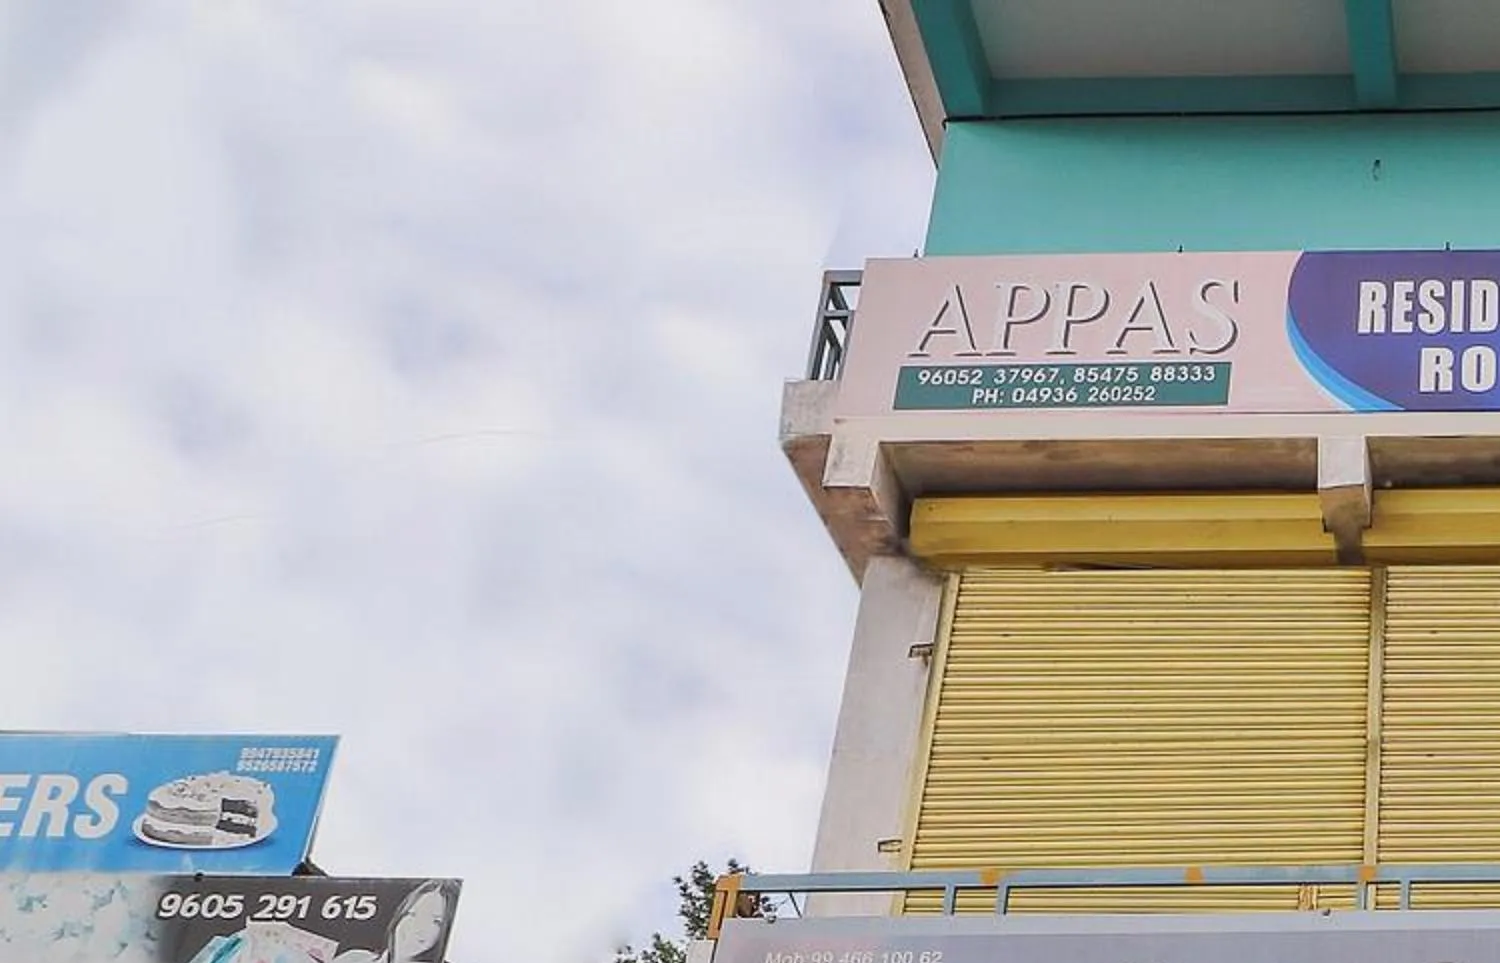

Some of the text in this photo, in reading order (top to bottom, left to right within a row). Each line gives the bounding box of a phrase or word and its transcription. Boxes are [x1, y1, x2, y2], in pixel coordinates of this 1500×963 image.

[908, 280, 1241, 356] APPAS
[918, 366, 1216, 385] 96052 37967, 85475 88333
[972, 386, 1157, 404] PH: 04936 260252
[158, 894, 377, 920] 9605 291 615
